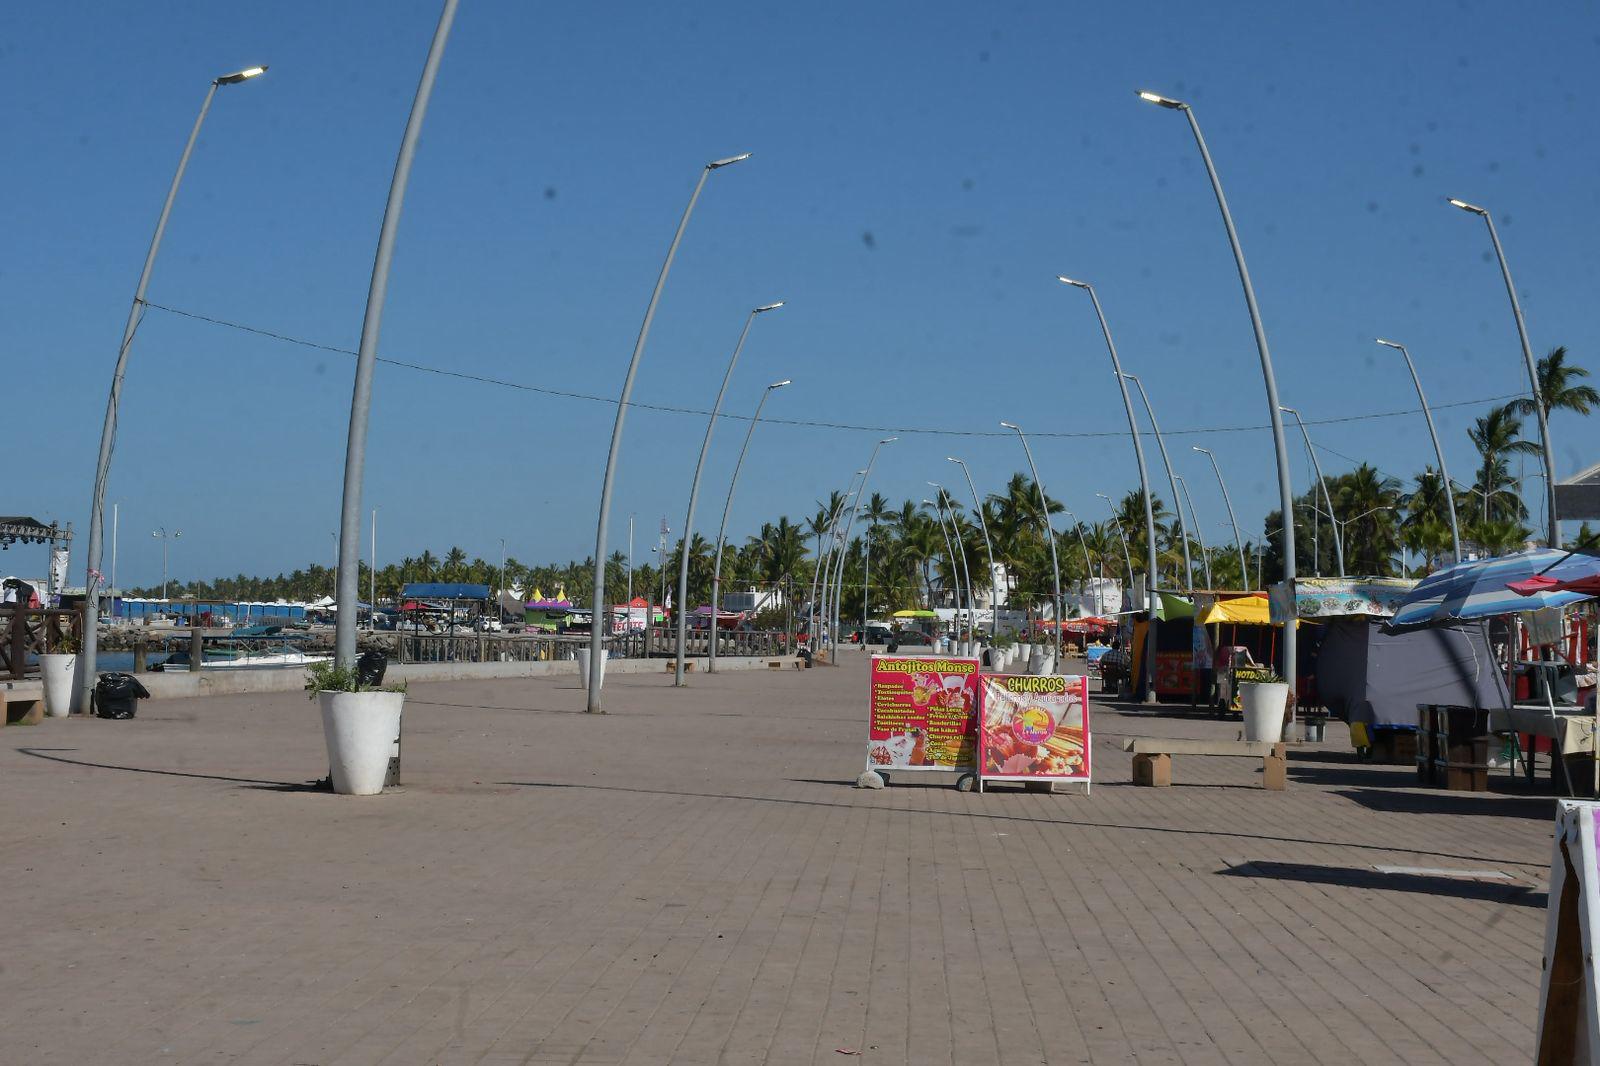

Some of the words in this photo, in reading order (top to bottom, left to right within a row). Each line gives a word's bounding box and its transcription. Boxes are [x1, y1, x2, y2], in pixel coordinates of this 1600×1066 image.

[612, 621, 643, 632] TECTE
[876, 659, 934, 674] Antojitos
[935, 660, 975, 673] Monse
[1007, 677, 1065, 692] CHURROS
